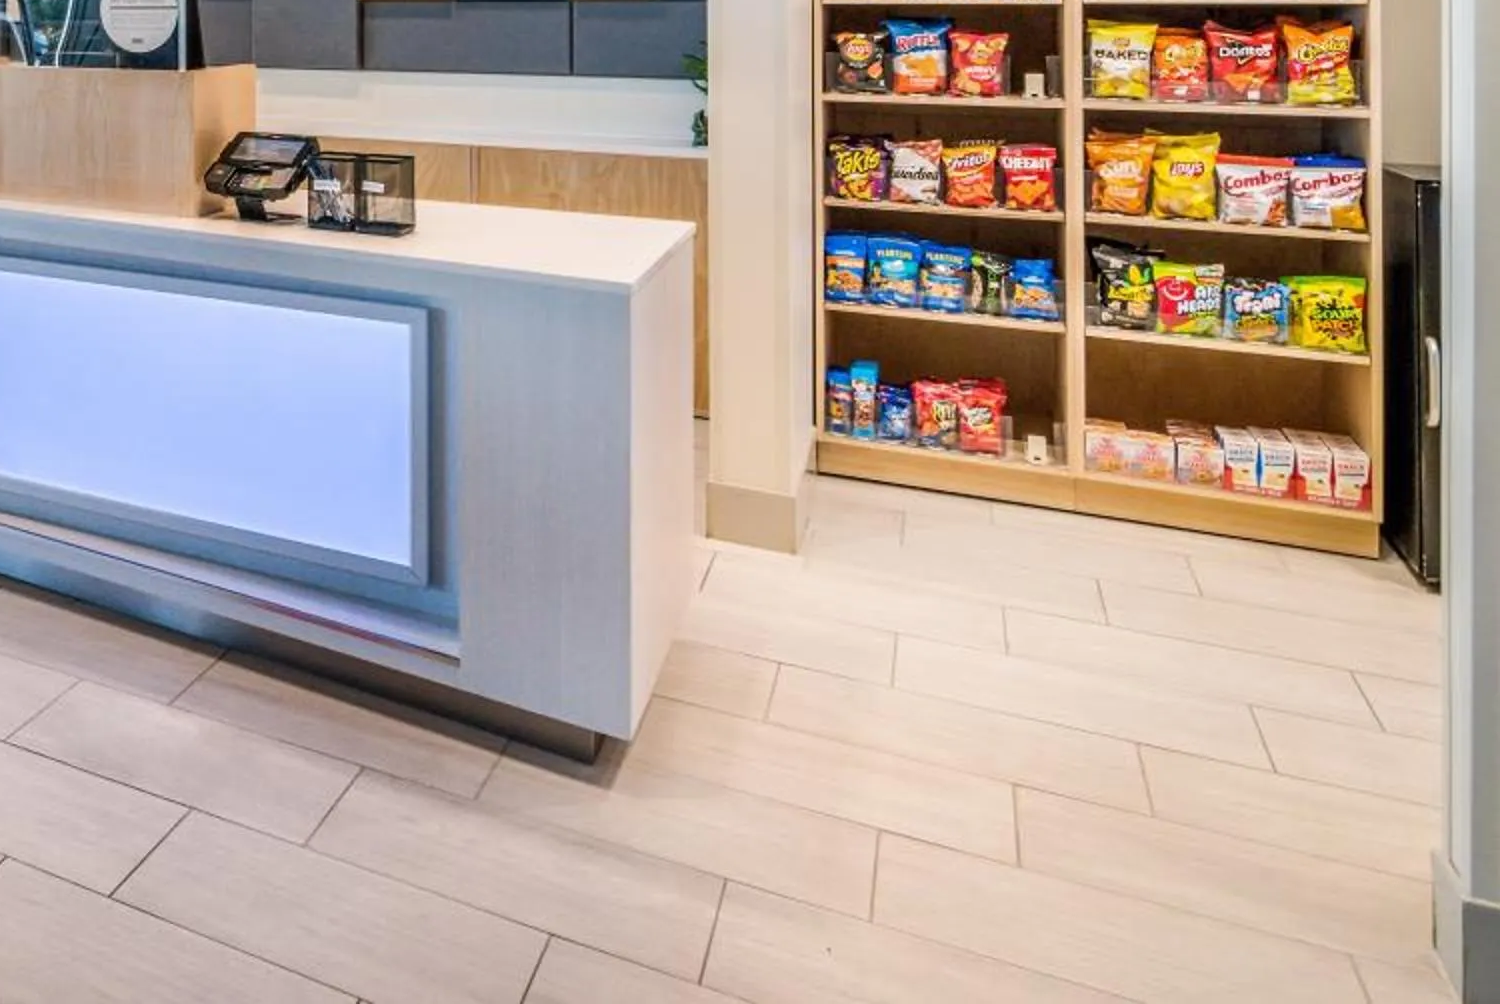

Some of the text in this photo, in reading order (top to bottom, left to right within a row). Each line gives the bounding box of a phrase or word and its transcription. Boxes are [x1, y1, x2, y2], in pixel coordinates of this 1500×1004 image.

[1095, 49, 1147, 60] BAKED
[1218, 45, 1272, 58] Doritos
[836, 147, 880, 175] Takis
[1223, 169, 1291, 190] Combos
[1292, 172, 1363, 192] Combos
